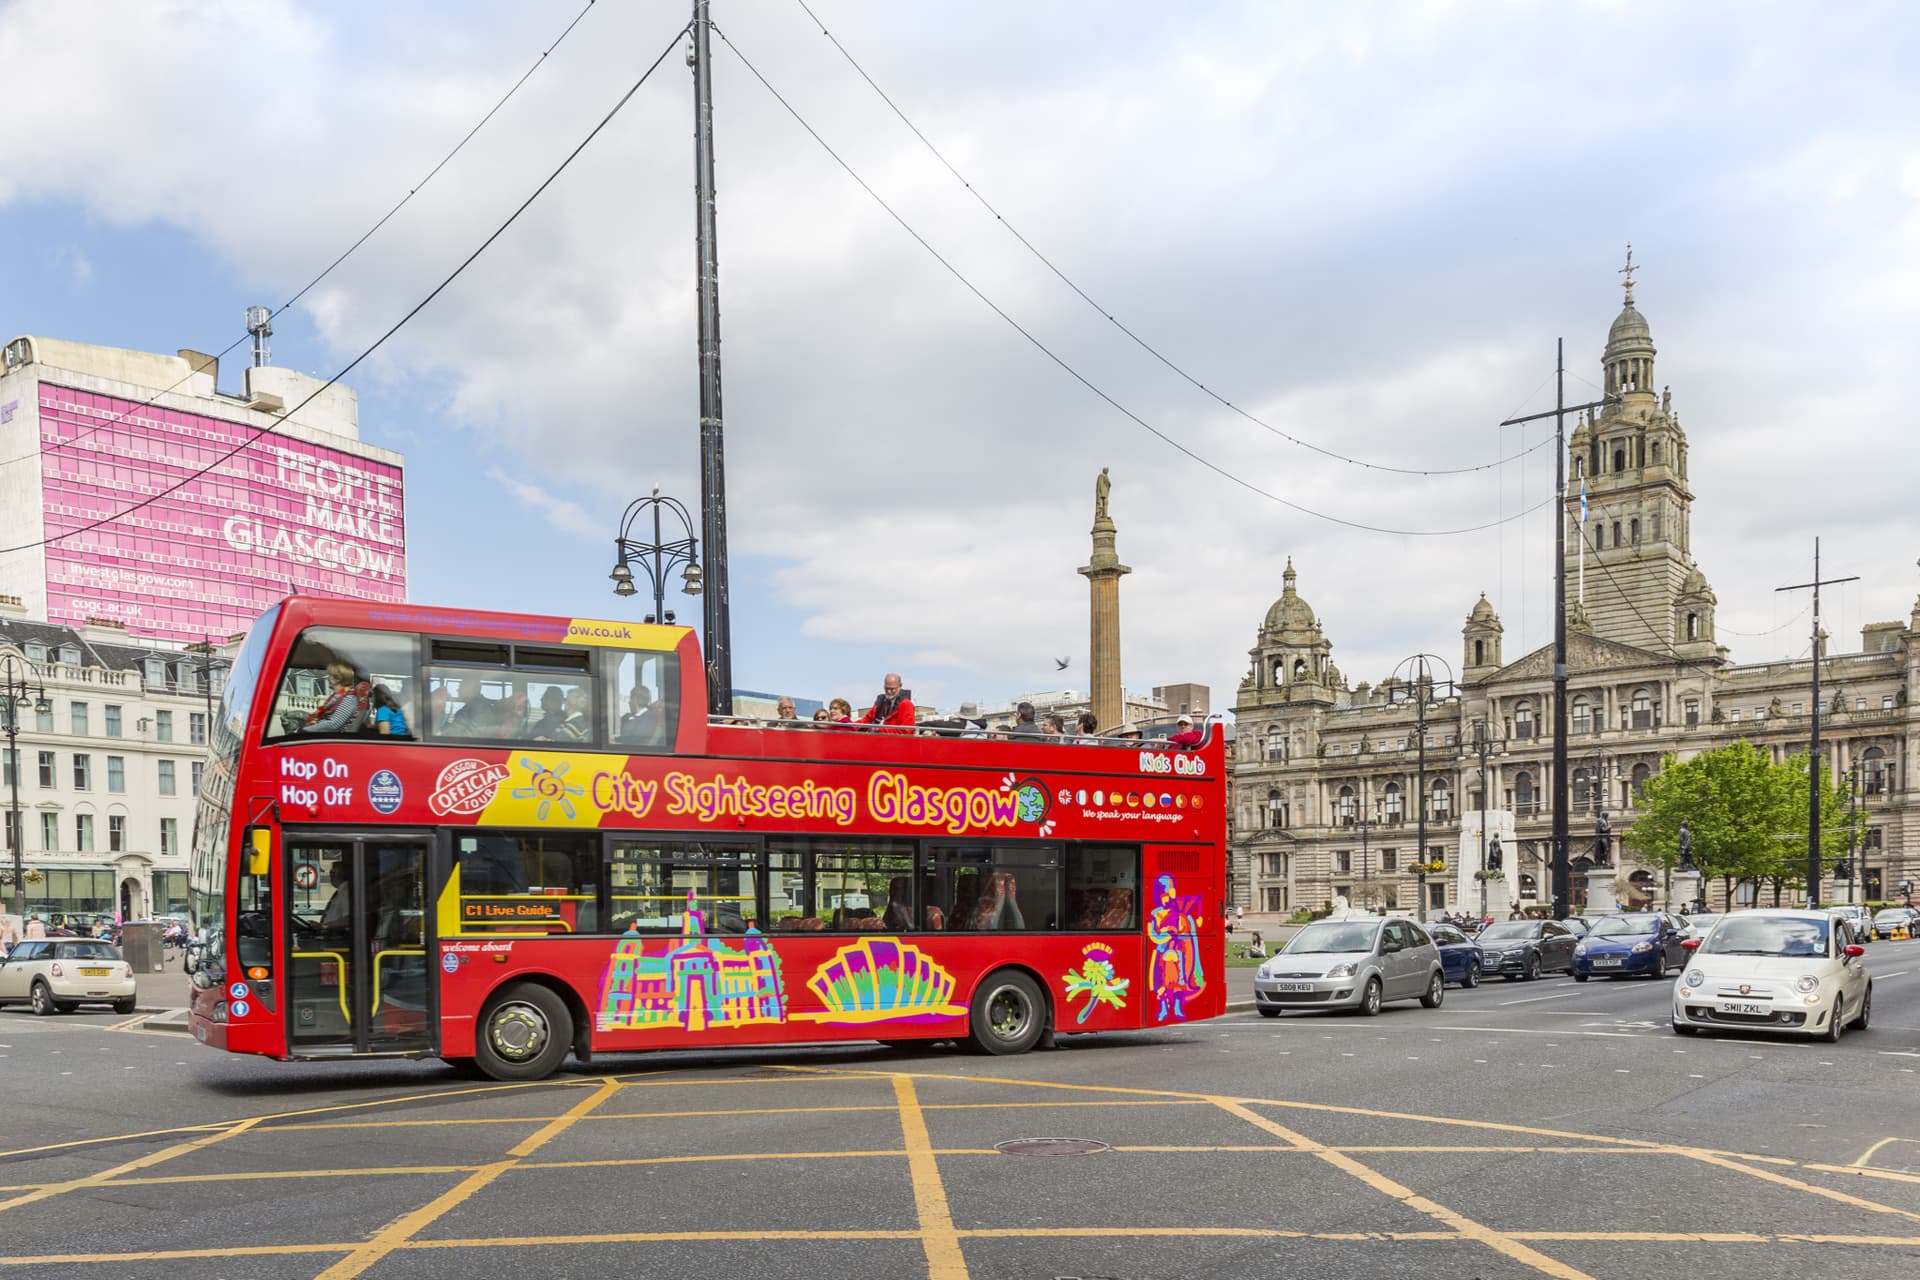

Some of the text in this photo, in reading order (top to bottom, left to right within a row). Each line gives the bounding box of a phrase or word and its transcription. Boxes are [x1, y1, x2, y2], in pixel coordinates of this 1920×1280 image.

[276, 447, 393, 509] PEOPLE
[305, 495, 394, 543] MAKE
[224, 515, 394, 580] GLASGOW
[70, 562, 193, 589] investglasgow.com
[72, 599, 142, 616] cogc.ac.uk
[281, 757, 348, 780] Hop On
[444, 761, 478, 782] GLASGOW
[1139, 752, 1206, 775] Kids Club
[282, 785, 352, 808] Hop Off
[438, 767, 507, 808] OFFICIAL
[464, 788, 495, 809] TOUR
[591, 770, 1020, 833] City Sightseeing Glasgow
[1082, 809, 1183, 823] We speak your language
[485, 905, 515, 916] Live
[517, 905, 553, 916] Guide
[442, 941, 514, 952] welcome aboard
[1744, 1004, 1762, 1013] ZKL
